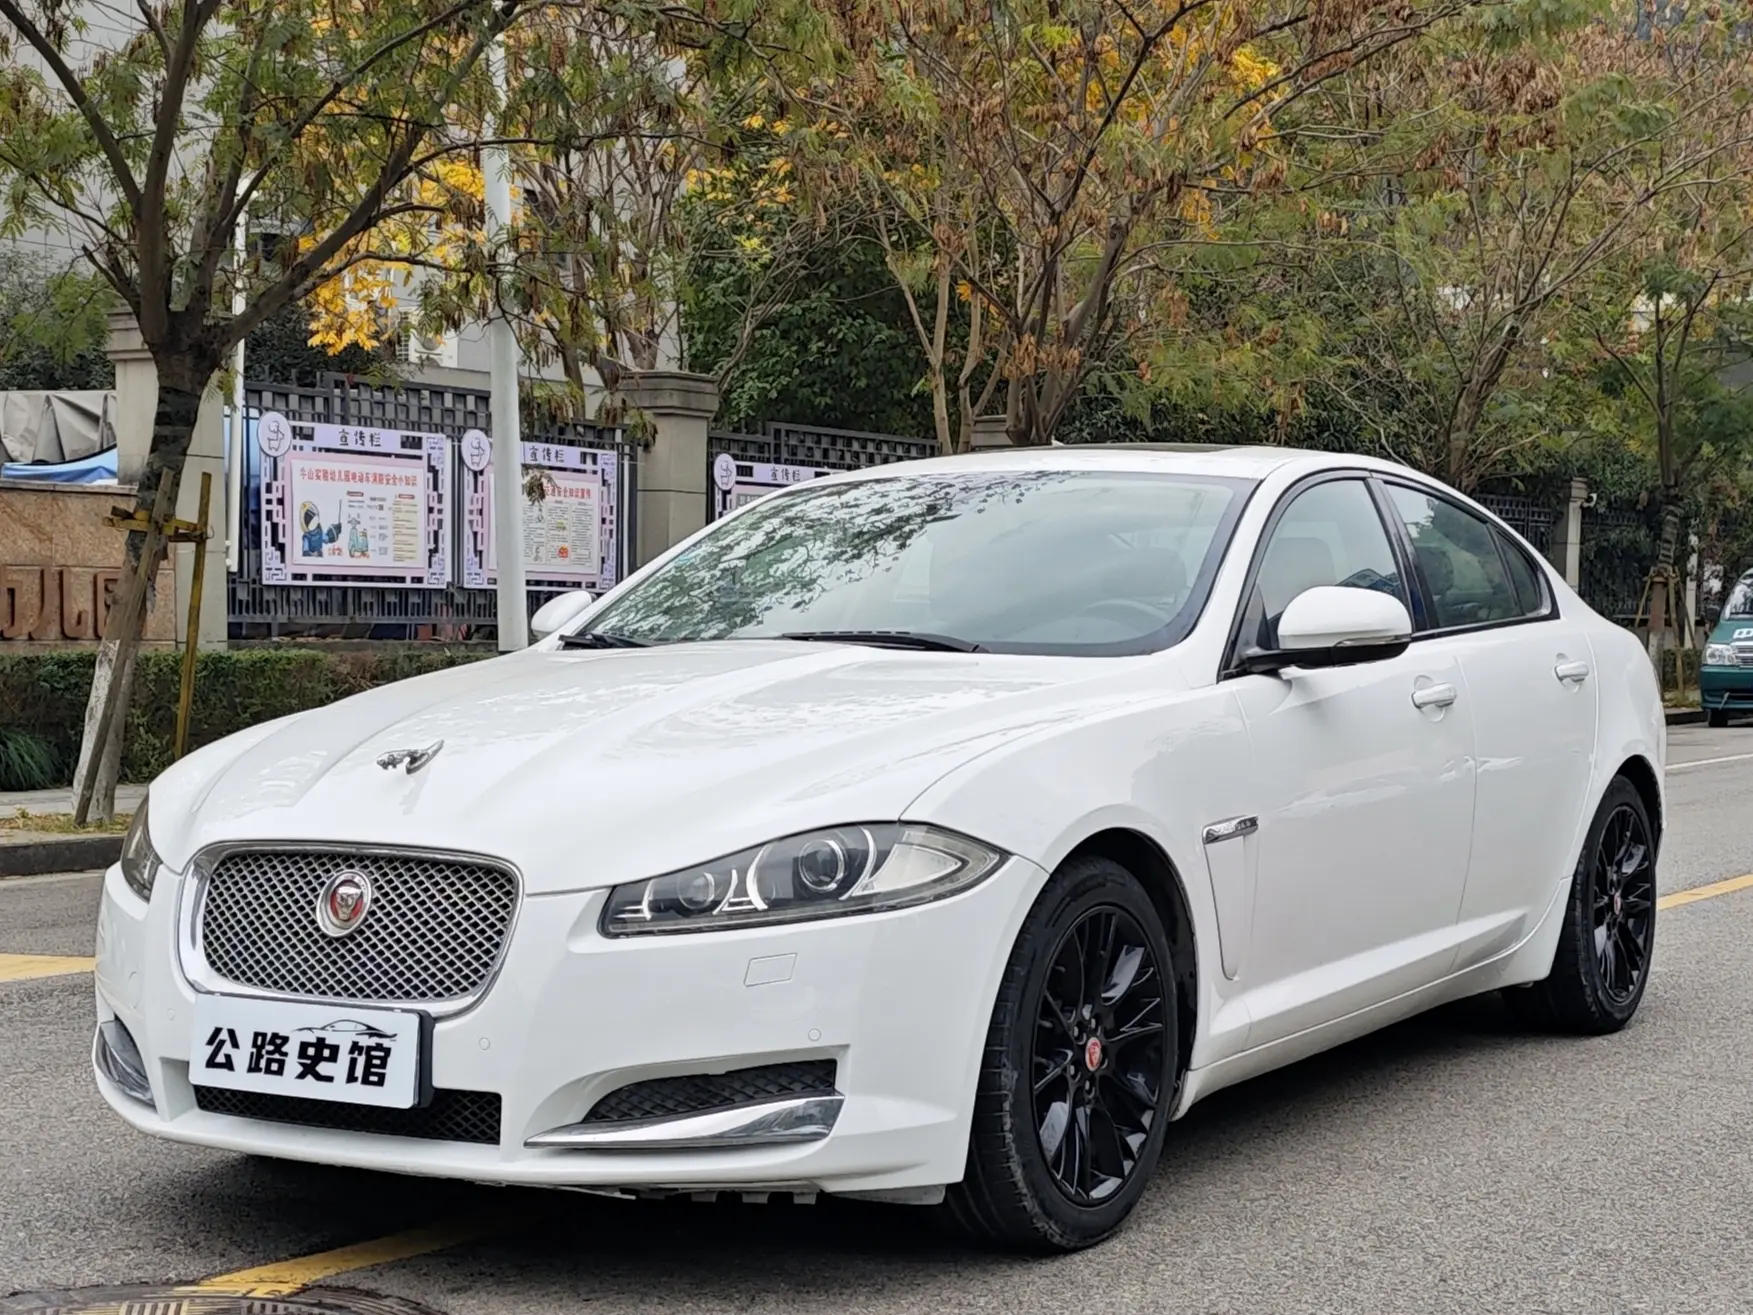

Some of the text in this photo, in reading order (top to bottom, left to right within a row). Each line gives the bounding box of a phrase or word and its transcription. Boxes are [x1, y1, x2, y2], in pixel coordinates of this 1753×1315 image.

[338, 428, 381, 447] 宣传栏
[530, 445, 564, 463] 宣传栏
[770, 466, 800, 482] 宣传栏
[204, 1026, 392, 1088] 公路史馆
